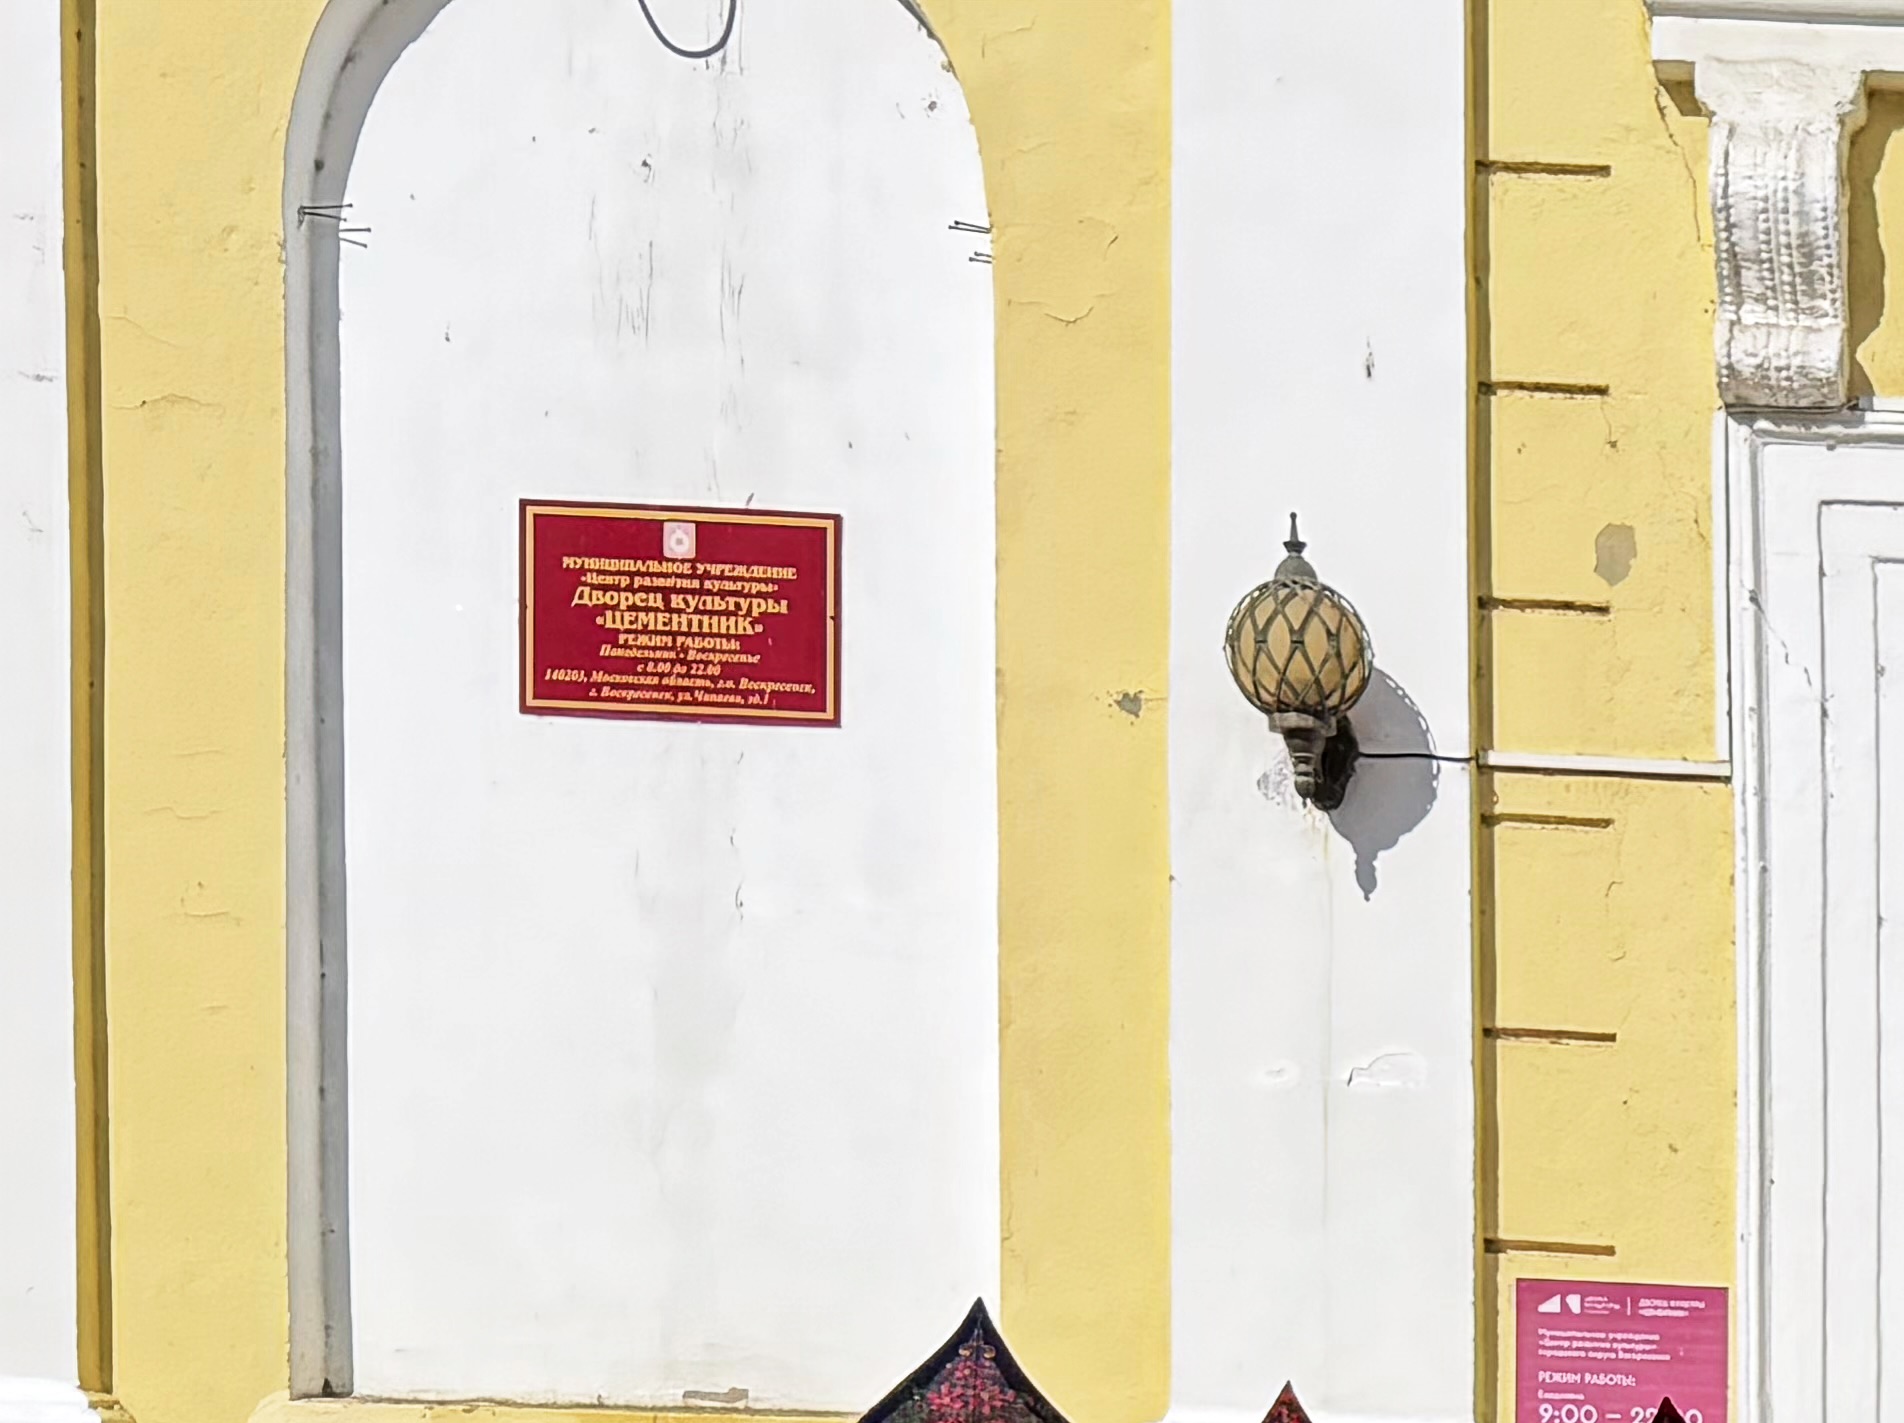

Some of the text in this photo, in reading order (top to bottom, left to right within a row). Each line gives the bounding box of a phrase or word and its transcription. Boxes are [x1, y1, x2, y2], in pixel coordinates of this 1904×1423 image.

[570, 586, 789, 617] Дворец культуры
[595, 609, 764, 635] «ЦЕМЕНТНИК»
[1537, 1370, 1582, 1385] РЕЖИМ
